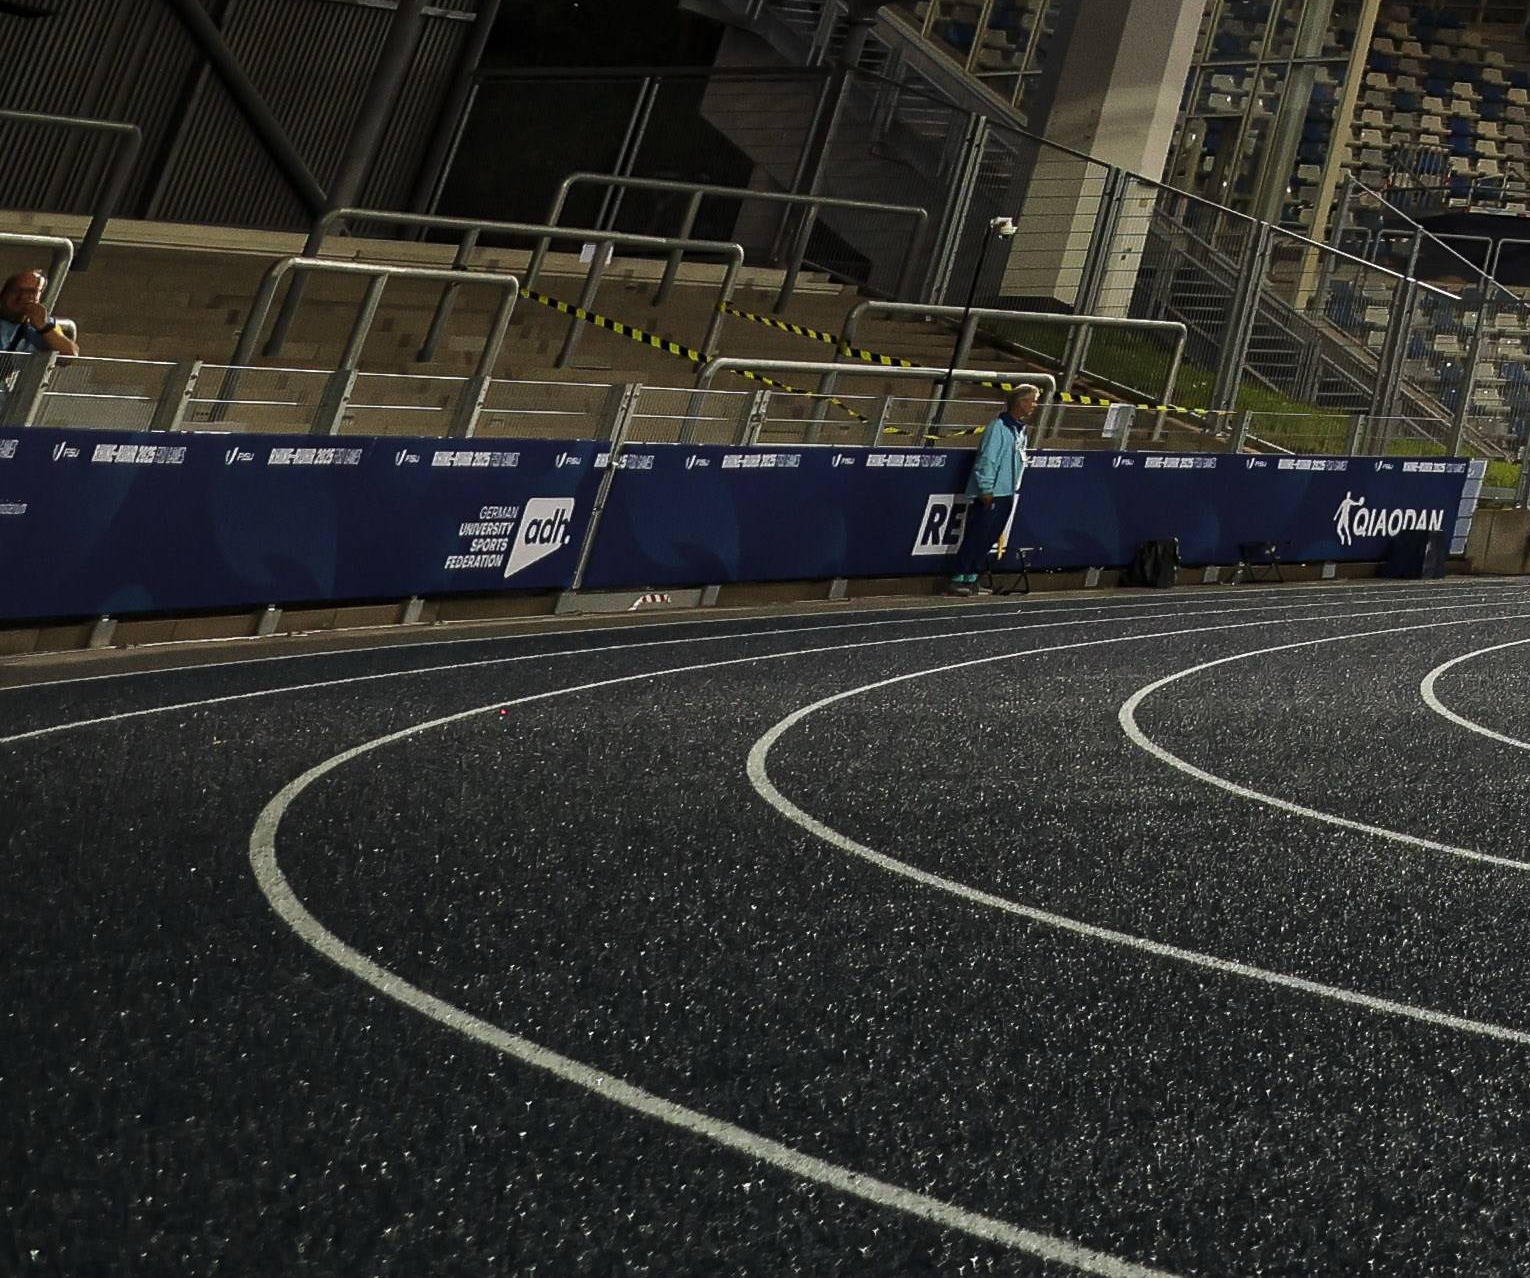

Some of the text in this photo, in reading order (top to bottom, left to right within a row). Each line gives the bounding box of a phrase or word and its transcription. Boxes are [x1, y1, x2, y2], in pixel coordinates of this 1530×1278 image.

[479, 506, 519, 519] GERMAN
[459, 522, 514, 536] UNIVERSITY
[920, 503, 967, 546] RE
[1353, 507, 1444, 537] QIAODAN
[470, 538, 509, 552] SPORTS
[445, 554, 504, 569] FEDERATION
